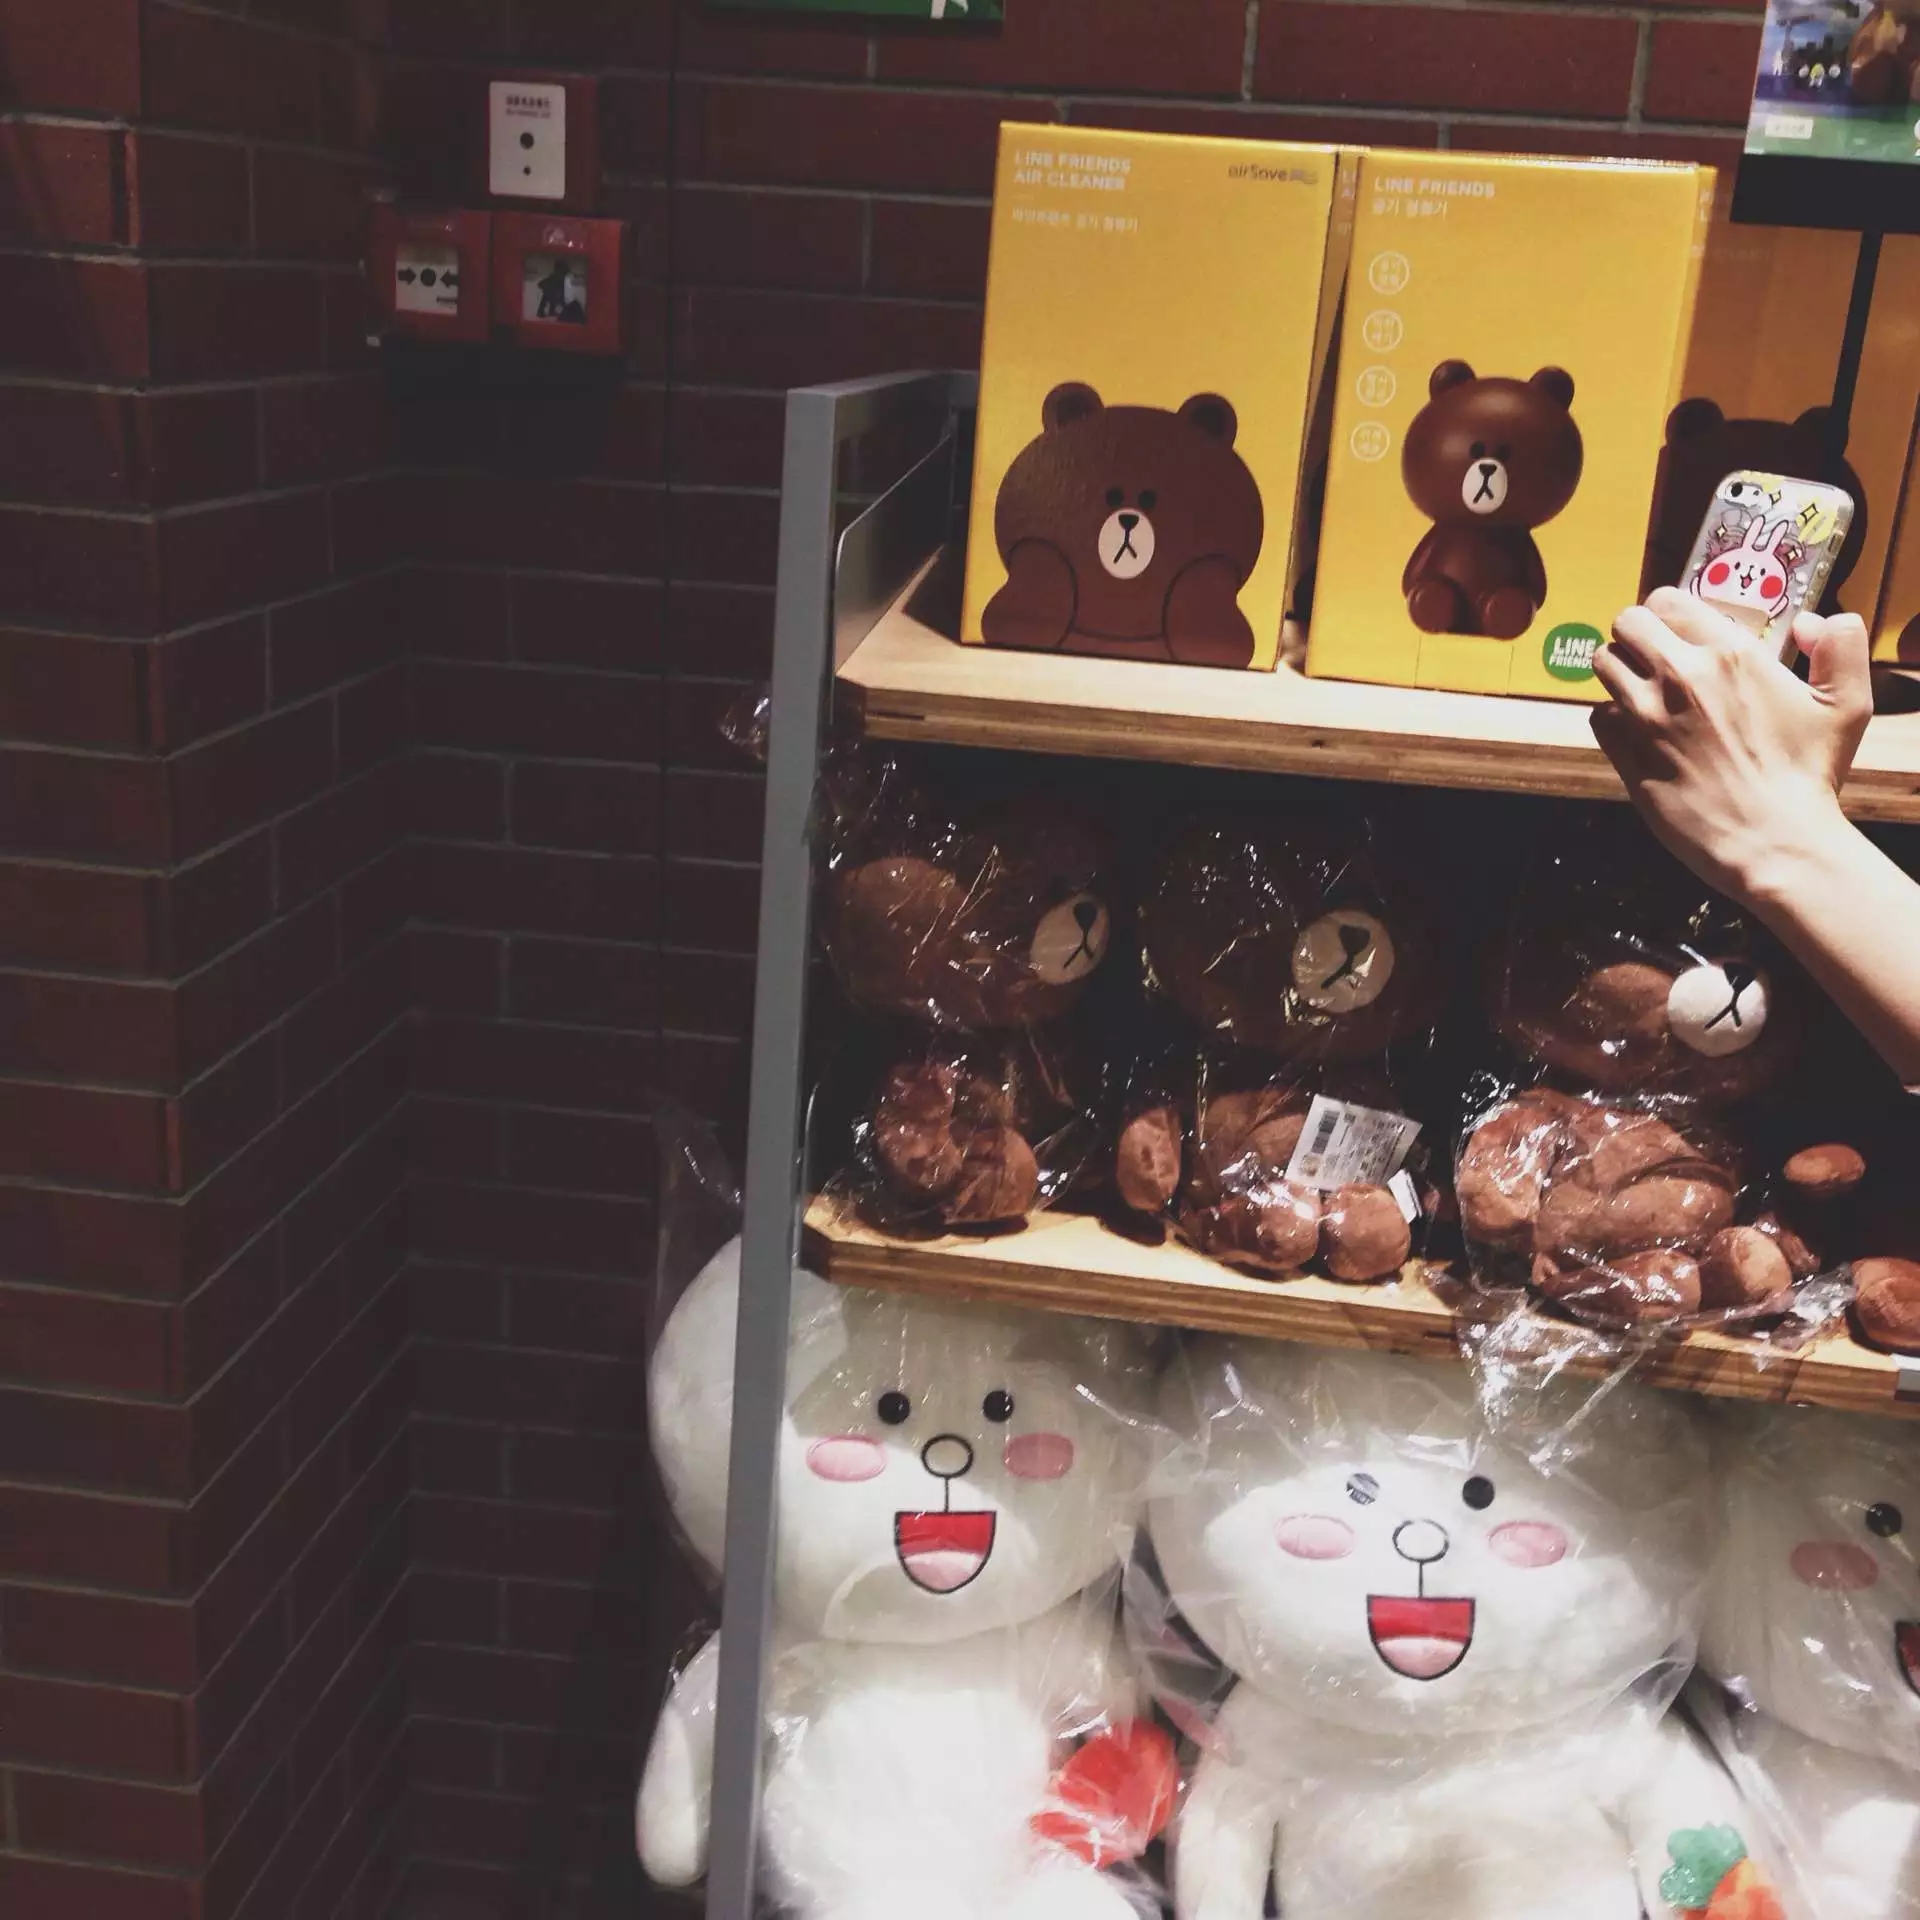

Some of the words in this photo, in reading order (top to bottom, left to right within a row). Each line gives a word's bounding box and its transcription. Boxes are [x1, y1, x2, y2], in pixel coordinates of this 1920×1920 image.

[1015, 151, 1053, 167] LINE
[1058, 153, 1131, 174] FRIENDS
[1014, 169, 1042, 184] AIR
[1047, 171, 1125, 190] CLEANER
[1375, 176, 1413, 193] LINE
[1418, 178, 1495, 199] FRIENDS
[1554, 637, 1596, 656] LINE
